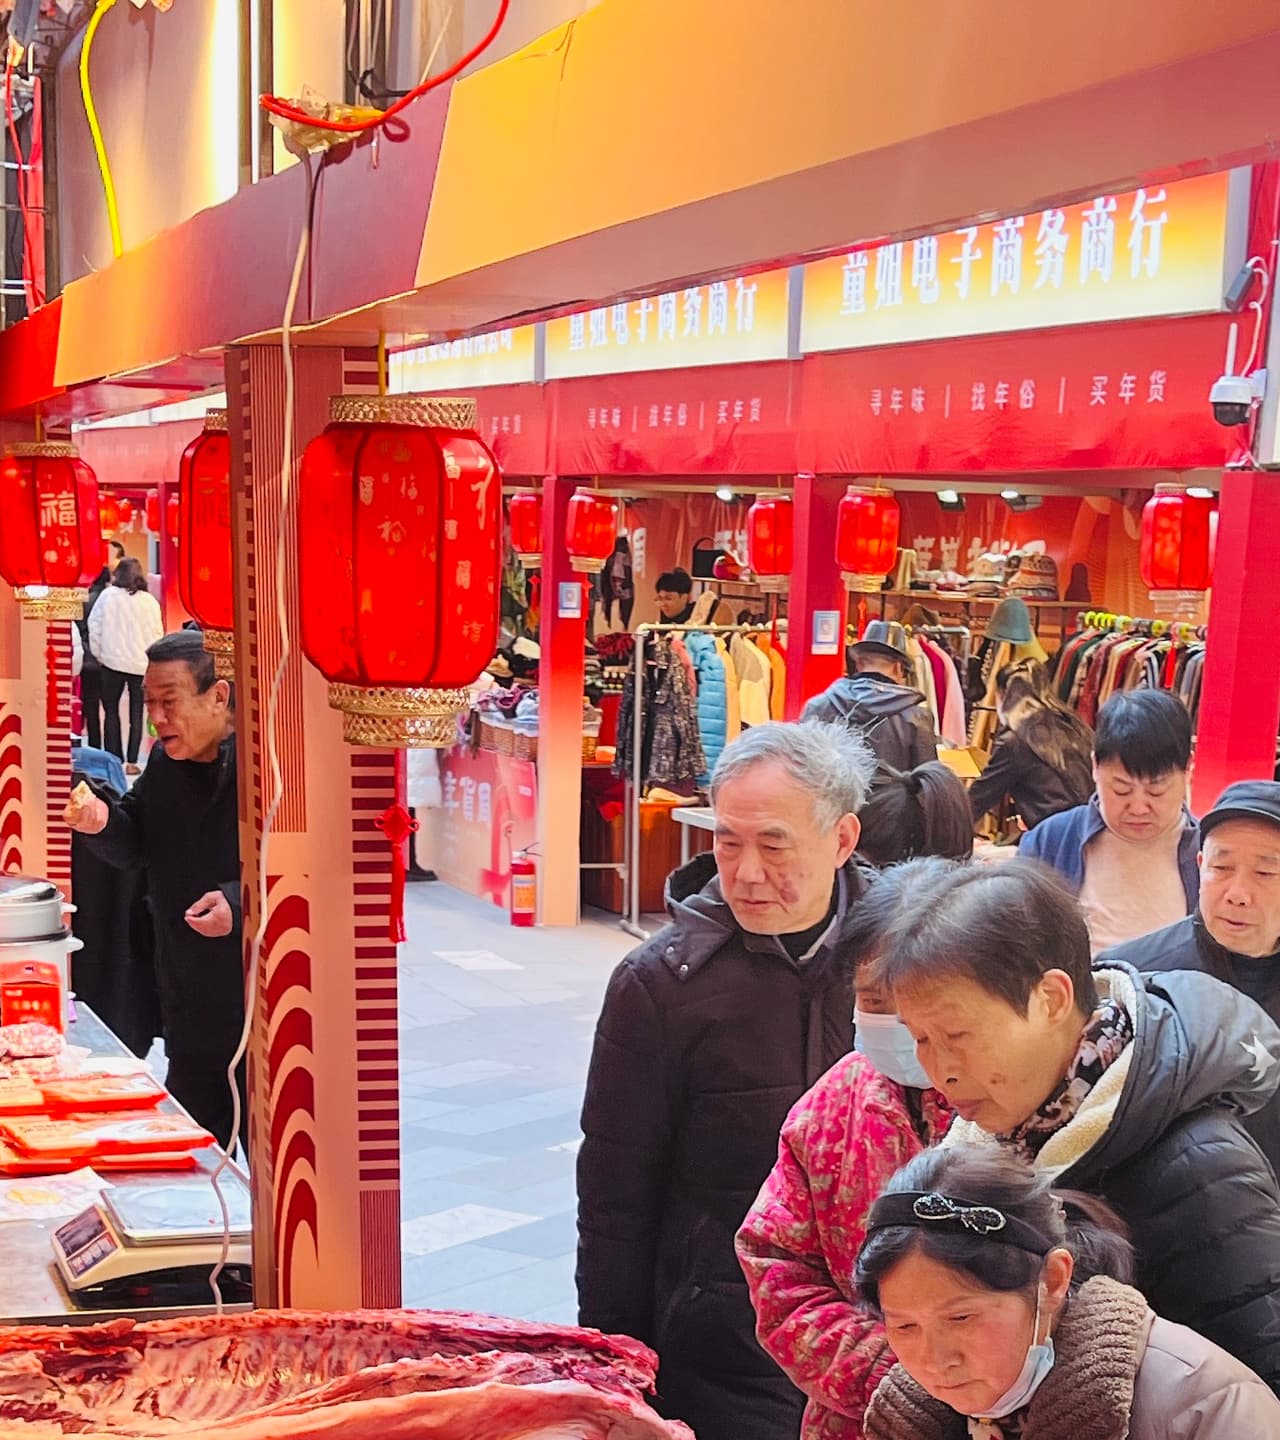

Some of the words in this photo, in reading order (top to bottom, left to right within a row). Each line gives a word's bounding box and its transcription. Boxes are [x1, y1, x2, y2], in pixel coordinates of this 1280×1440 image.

[869, 388, 926, 416] 寻年味
[1090, 371, 1167, 405] 买年货
[40, 490, 77, 528] 福
